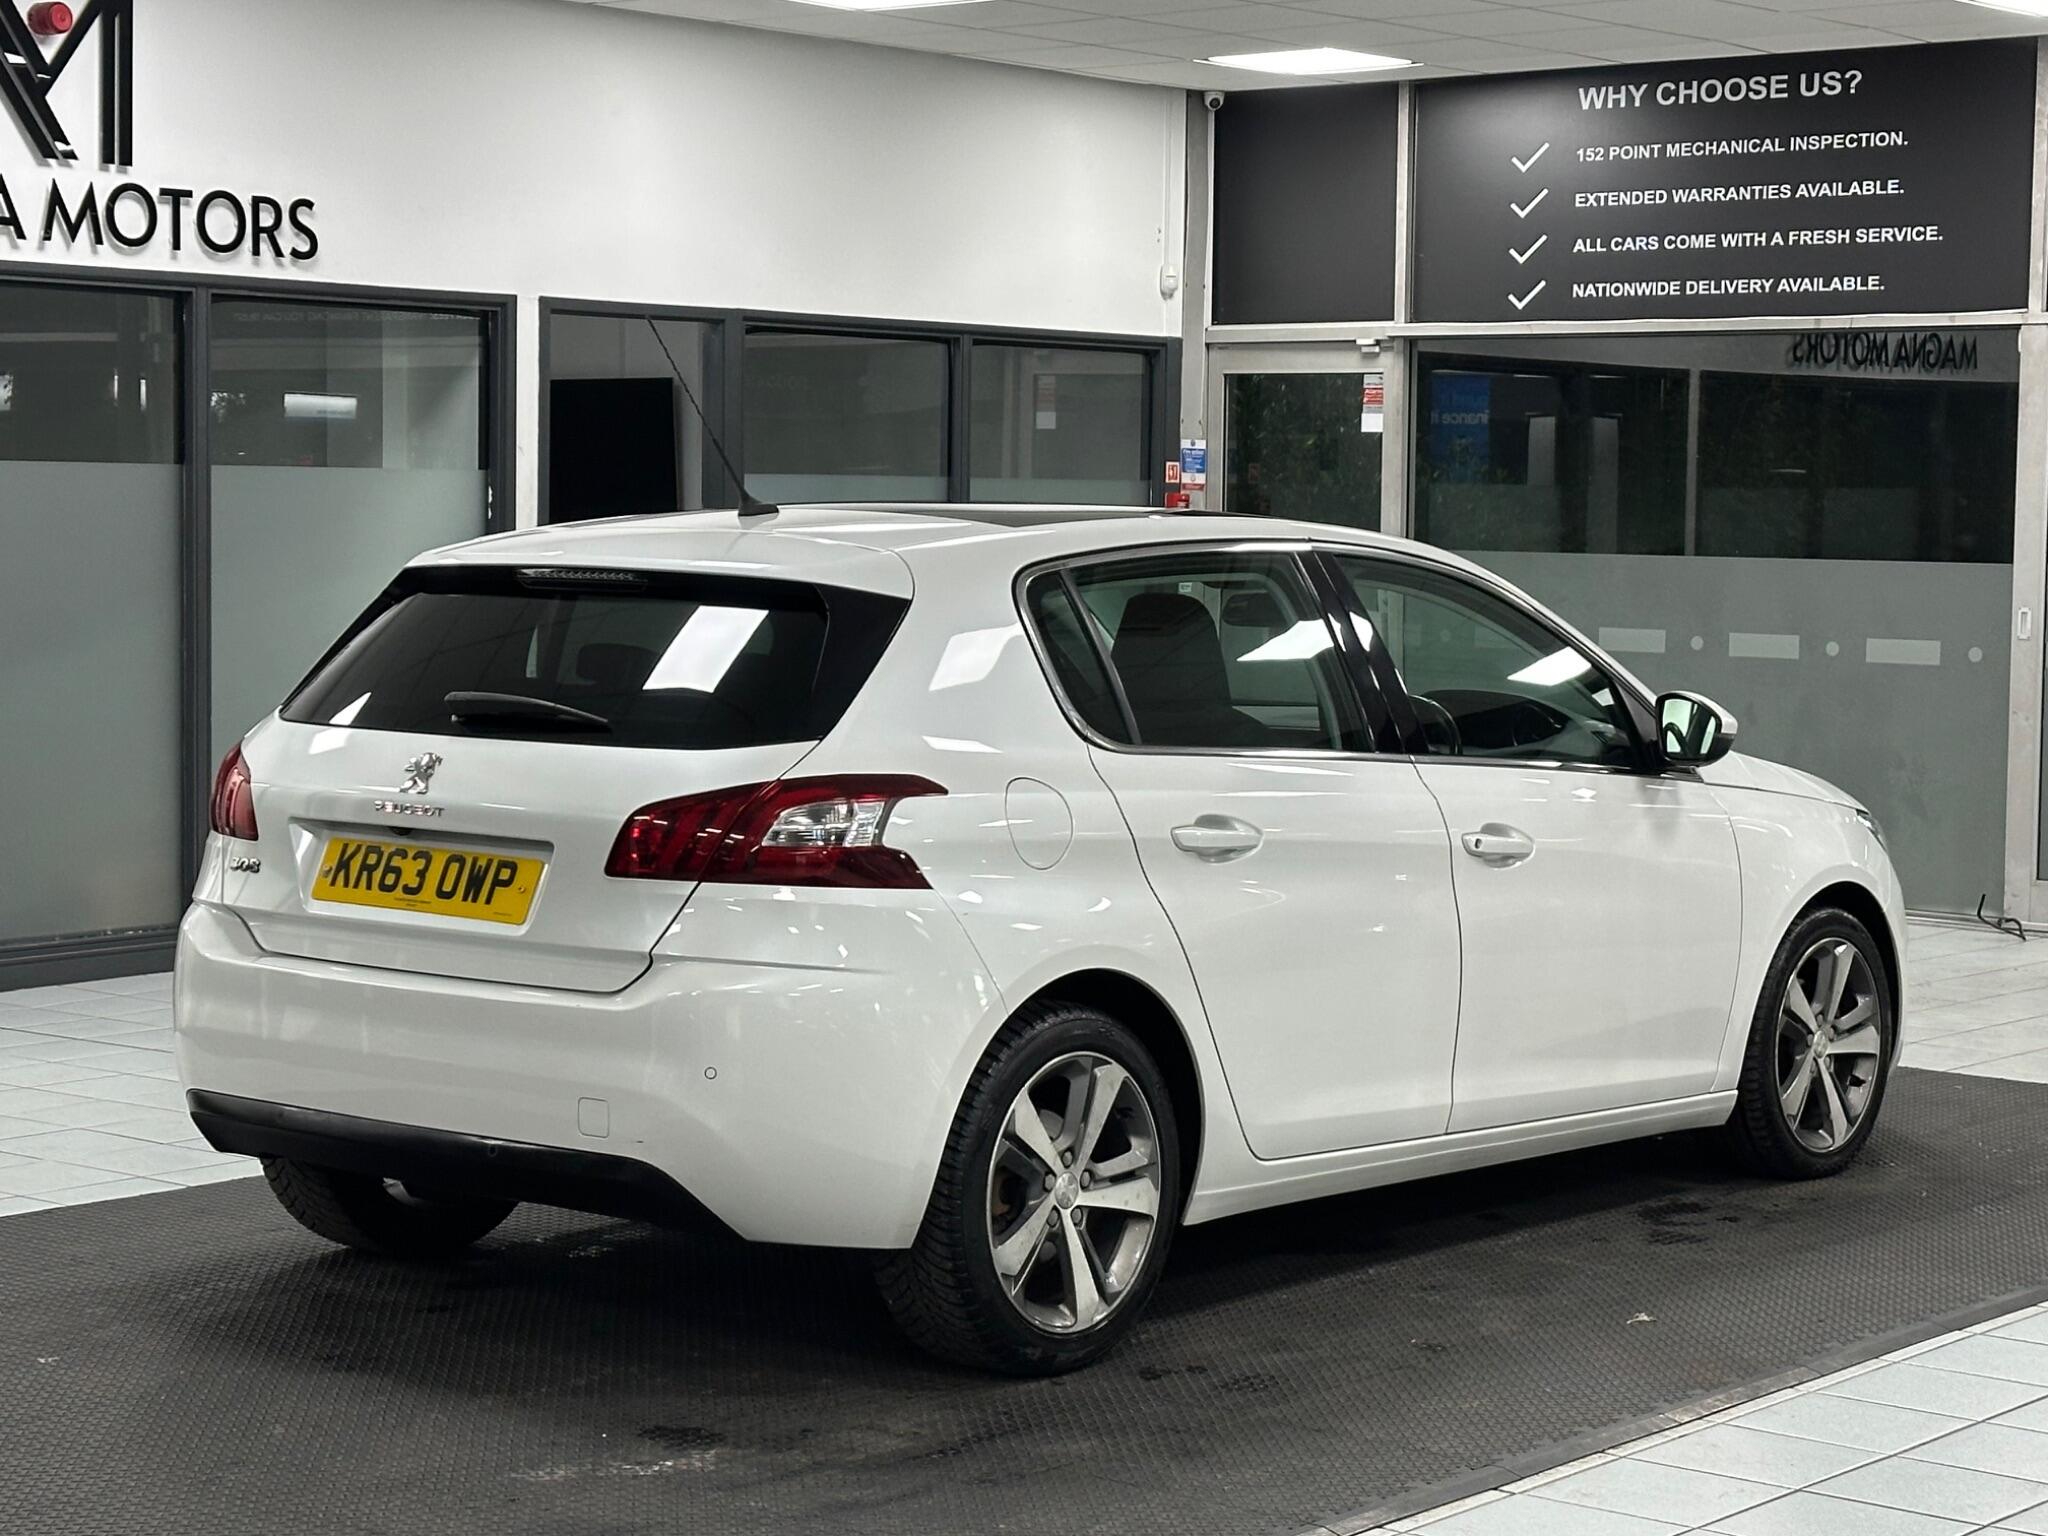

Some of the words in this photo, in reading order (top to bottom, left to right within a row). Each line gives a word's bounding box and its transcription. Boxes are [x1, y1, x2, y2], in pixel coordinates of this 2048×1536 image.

[1578, 83, 1648, 111] WHY
[1656, 75, 1789, 106] CHOOSE
[1800, 69, 1863, 97] US?
[1576, 147, 1604, 162] 152
[1609, 144, 1661, 160] POINT
[1666, 138, 1785, 158] MECHANICAL
[1790, 131, 1909, 151] INSPECTION.
[1575, 189, 1668, 207] EXTENDED
[1672, 184, 1791, 203] WARRANTIES
[1795, 179, 1905, 198] AVAILABLE.
[42, 178, 319, 260] MOTORS
[1573, 238, 1607, 253] ALL
[1610, 236, 1659, 252] CARS
[1663, 233, 1717, 250] COME
[1721, 231, 1767, 248] WITH
[1770, 232, 1784, 246] A
[1788, 229, 1851, 246] FRESH
[1855, 226, 1944, 244] SERVICE.
[1572, 281, 1681, 298] NATIONWIDE
[1685, 278, 1774, 296] DELIVERY
[1777, 275, 1885, 293] AVAILABLE.
[374, 800, 445, 817] PEUGEOT
[330, 843, 433, 896] KR63
[435, 854, 518, 905] OWP
